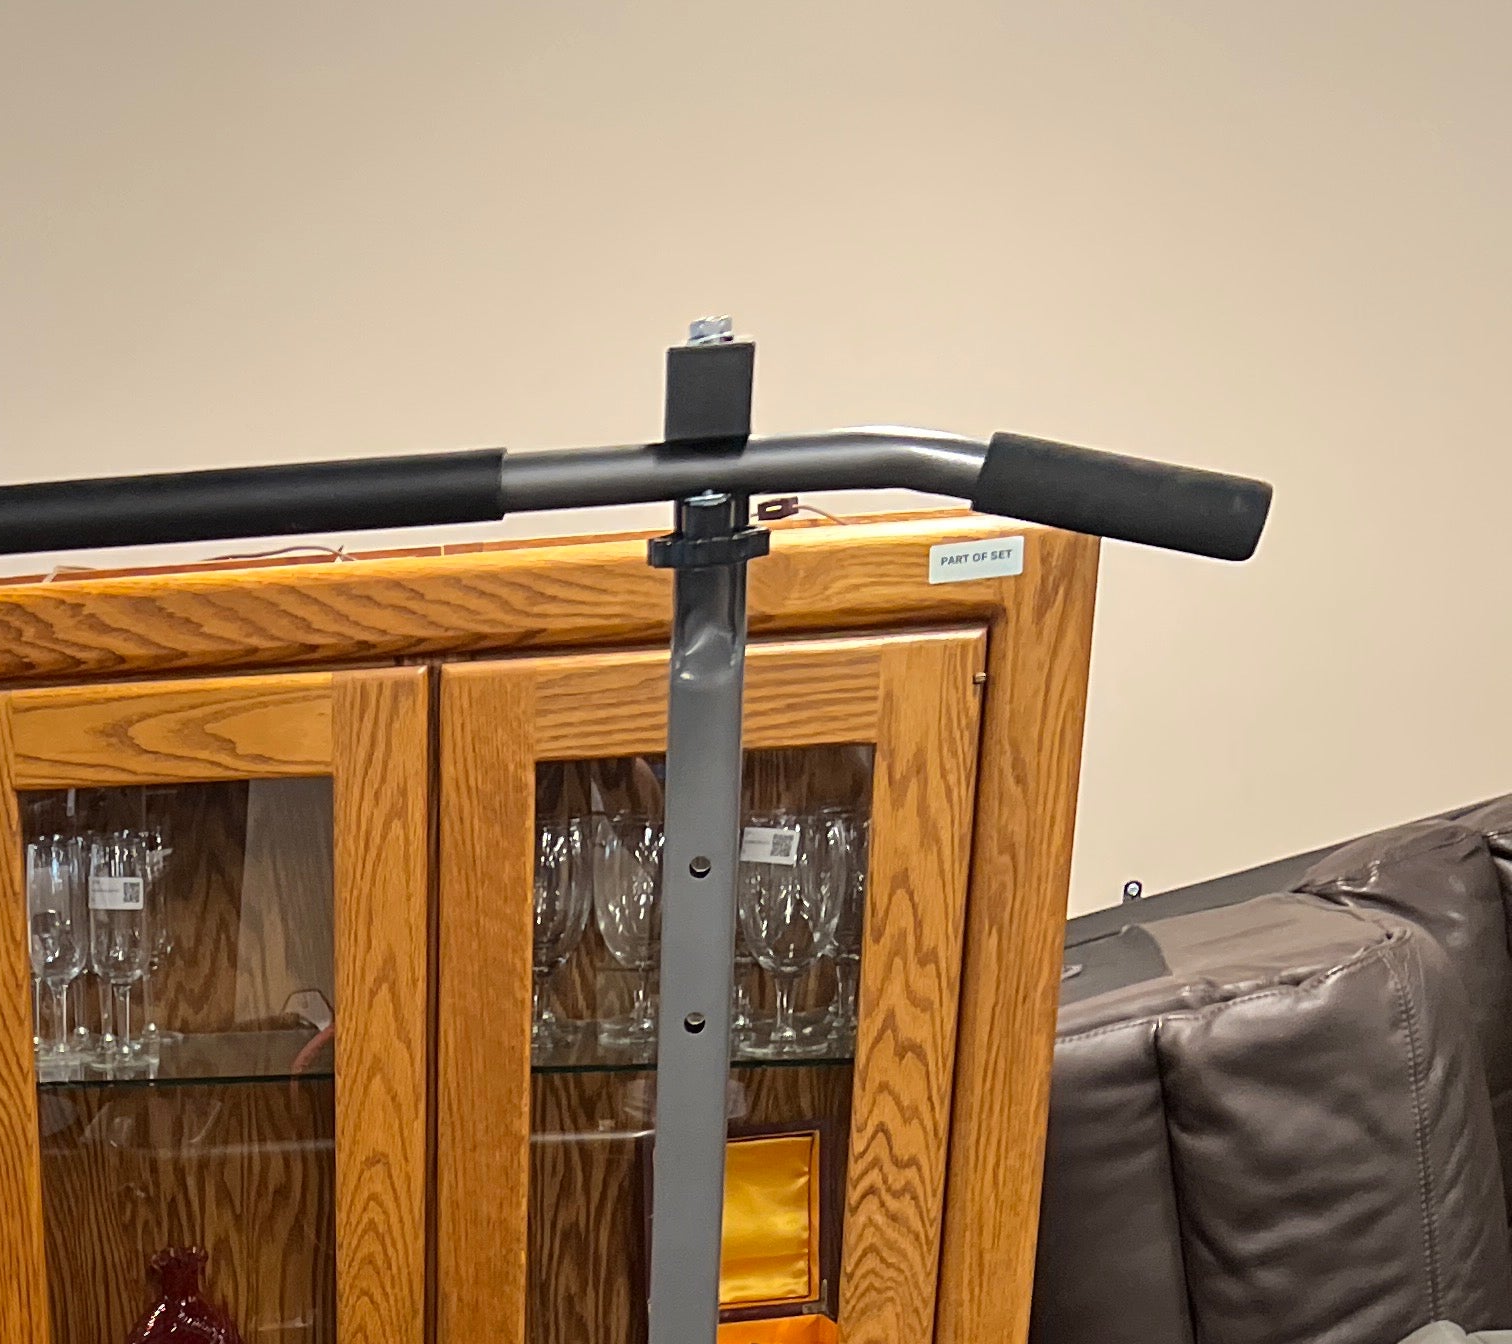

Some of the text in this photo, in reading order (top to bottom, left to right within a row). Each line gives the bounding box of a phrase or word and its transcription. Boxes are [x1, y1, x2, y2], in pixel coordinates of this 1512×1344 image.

[940, 549, 1013, 566] PART OF SET
